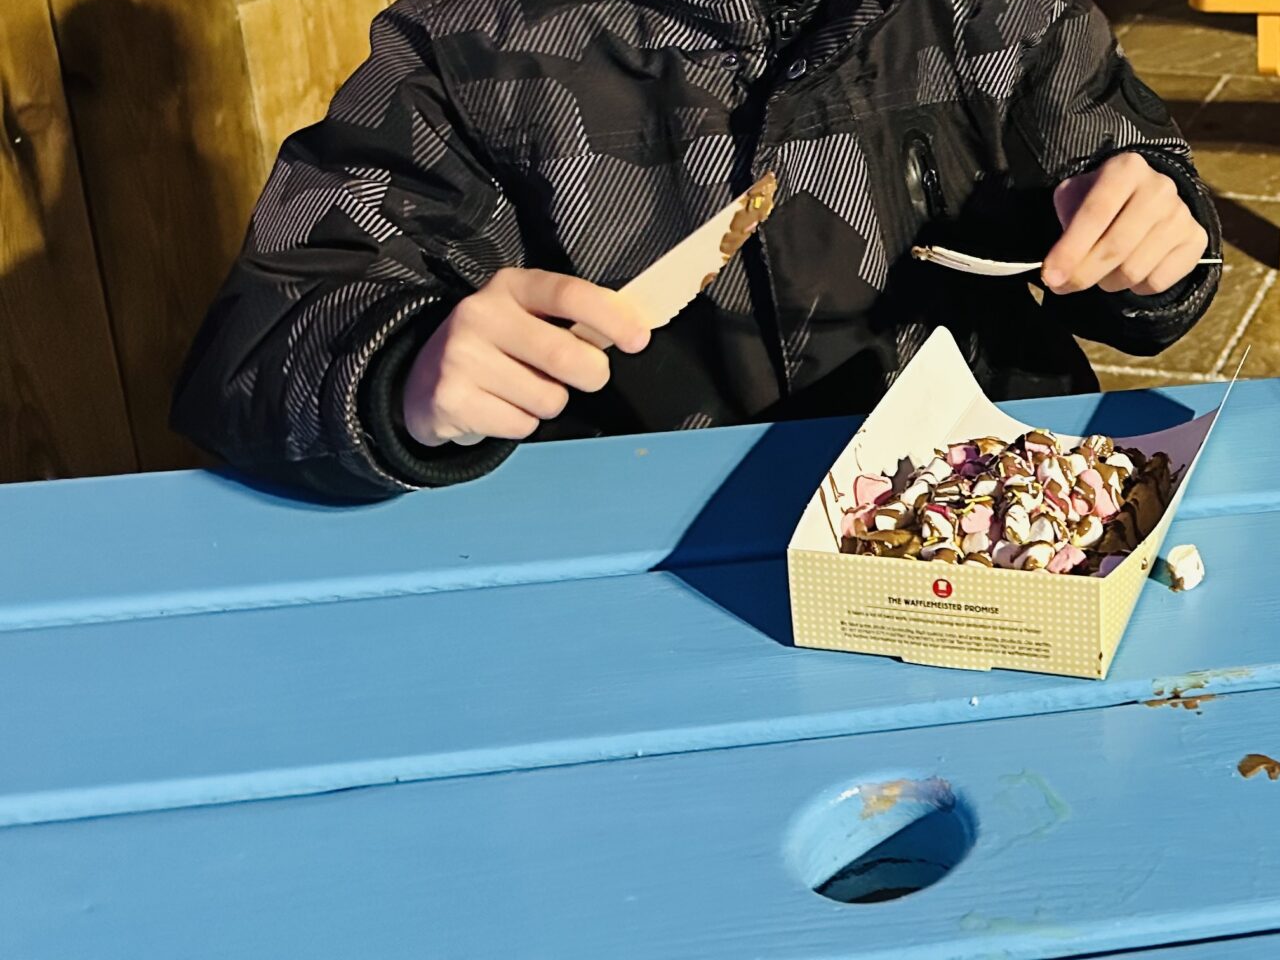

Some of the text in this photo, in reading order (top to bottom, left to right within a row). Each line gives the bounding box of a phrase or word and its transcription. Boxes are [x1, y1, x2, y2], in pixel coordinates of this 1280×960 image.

[887, 596, 999, 614] THE WAFFLEMEISTER PROMISE
